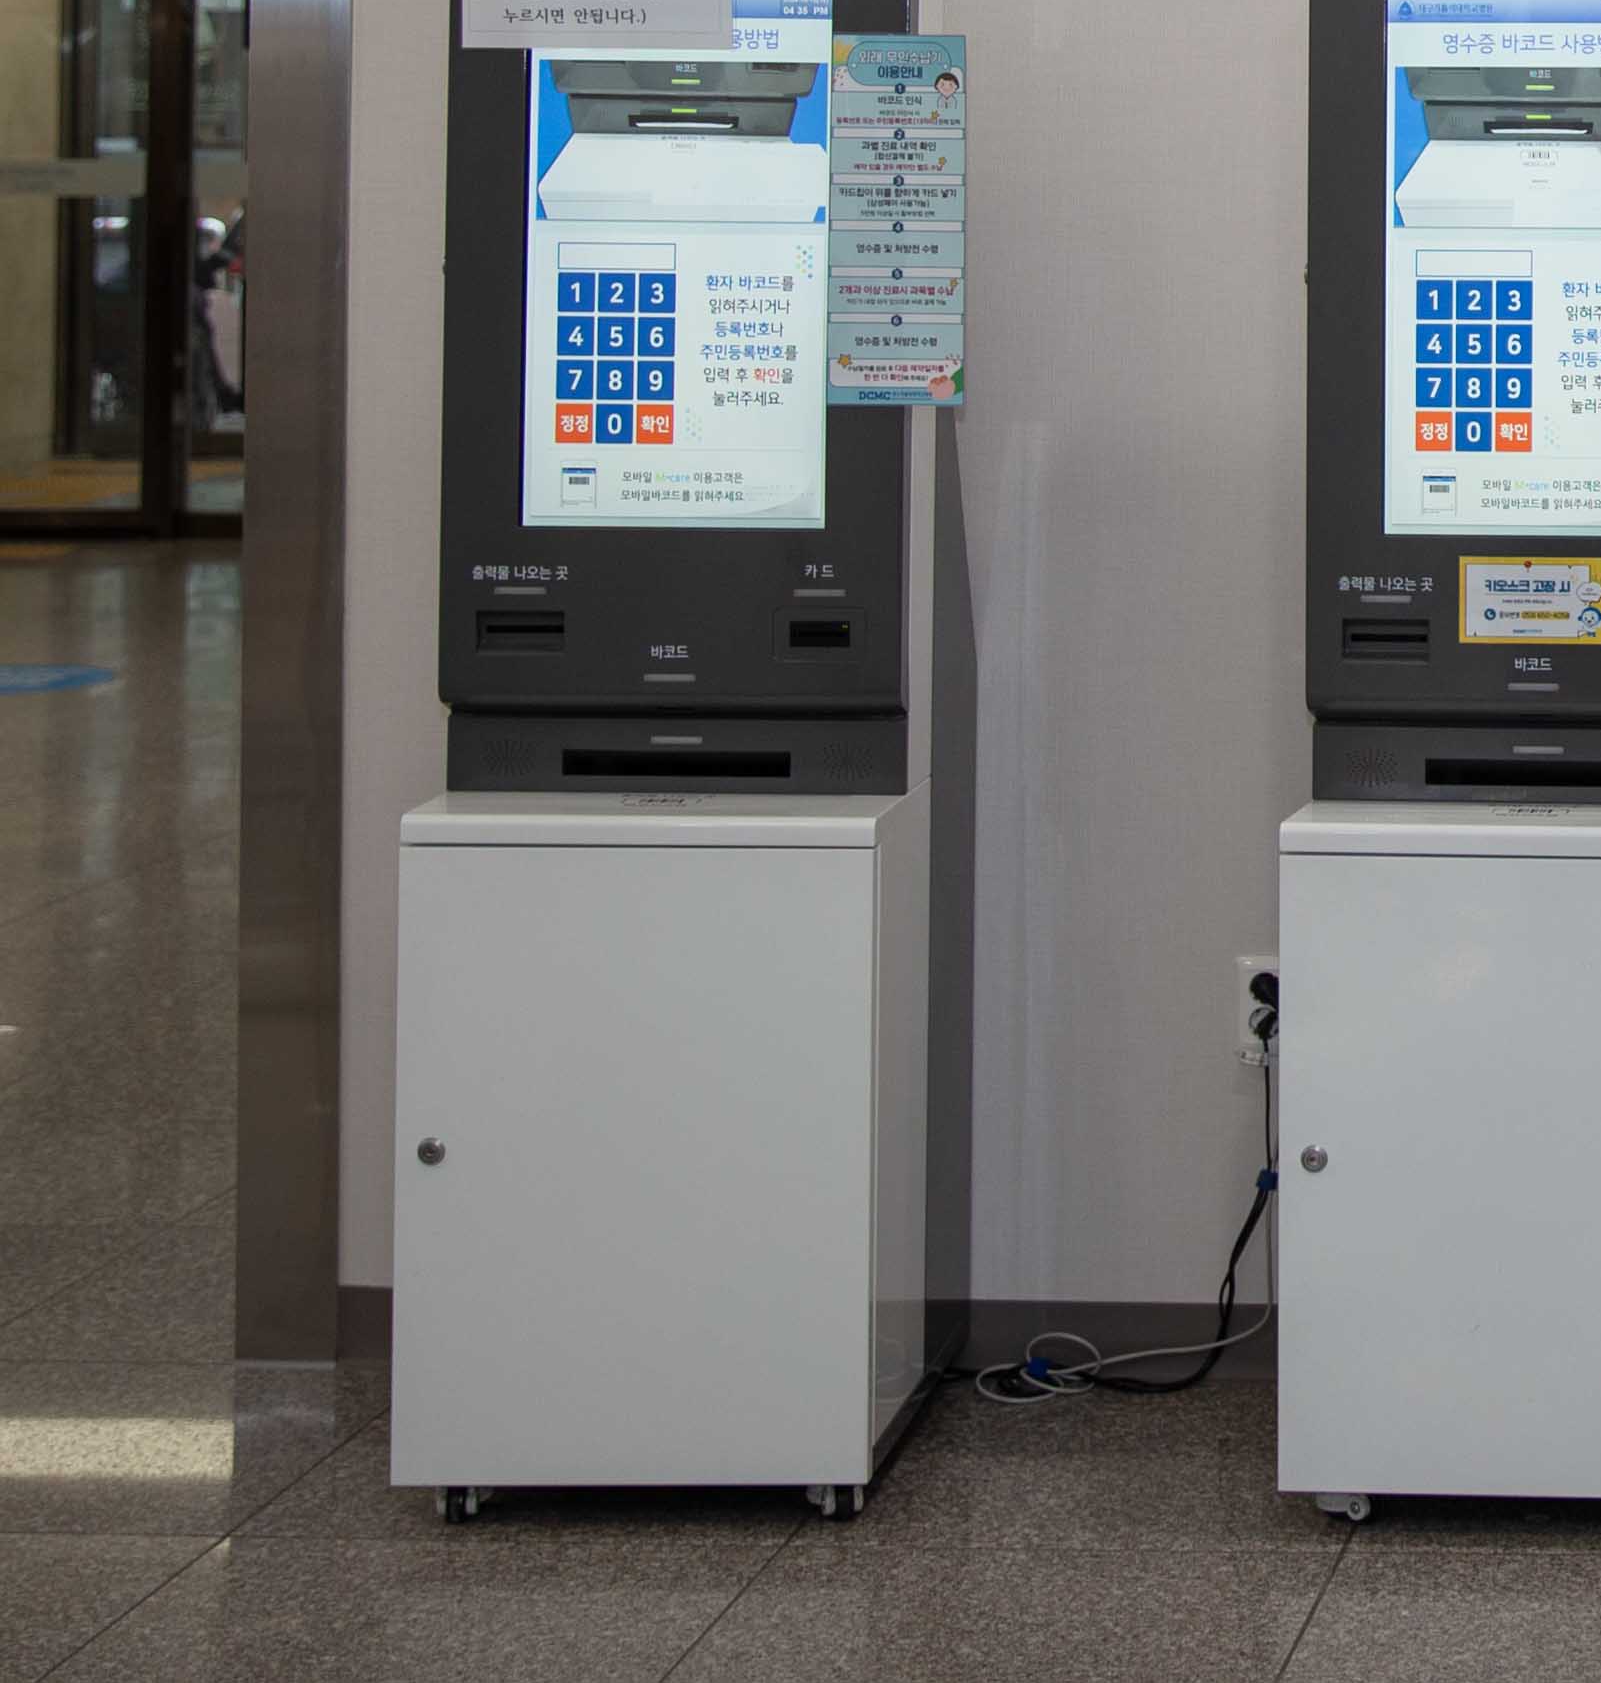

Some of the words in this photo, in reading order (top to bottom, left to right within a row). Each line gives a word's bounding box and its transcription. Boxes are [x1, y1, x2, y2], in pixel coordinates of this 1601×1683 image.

[504, 8, 564, 24] 누르시면
[1443, 34, 1495, 54] 영수증
[1502, 34, 1556, 54] 바코드
[878, 66, 923, 79] 이용안내
[705, 275, 732, 290] 환자
[739, 276, 794, 292] 바코드를
[709, 299, 790, 314] 읽혀주시거나
[714, 322, 783, 338] 등록번호나
[700, 345, 798, 360] 주민등록번호를
[704, 368, 729, 382] 입력
[736, 368, 748, 382] 후
[754, 368, 794, 383] 확인을
[713, 392, 784, 406] 눌러주세요.
[859, 392, 890, 400] DCMC
[560, 415, 589, 432] 정정
[607, 414, 621, 434] 0
[641, 415, 670, 433] 확인
[472, 565, 510, 579] 출력물
[514, 565, 552, 580] 나오는
[556, 565, 568, 580] 곳
[1485, 580, 1530, 593] 키오스크
[1533, 580, 1556, 593] 고장
[651, 645, 689, 659] 바코드
[1514, 658, 1552, 671] 바코드
